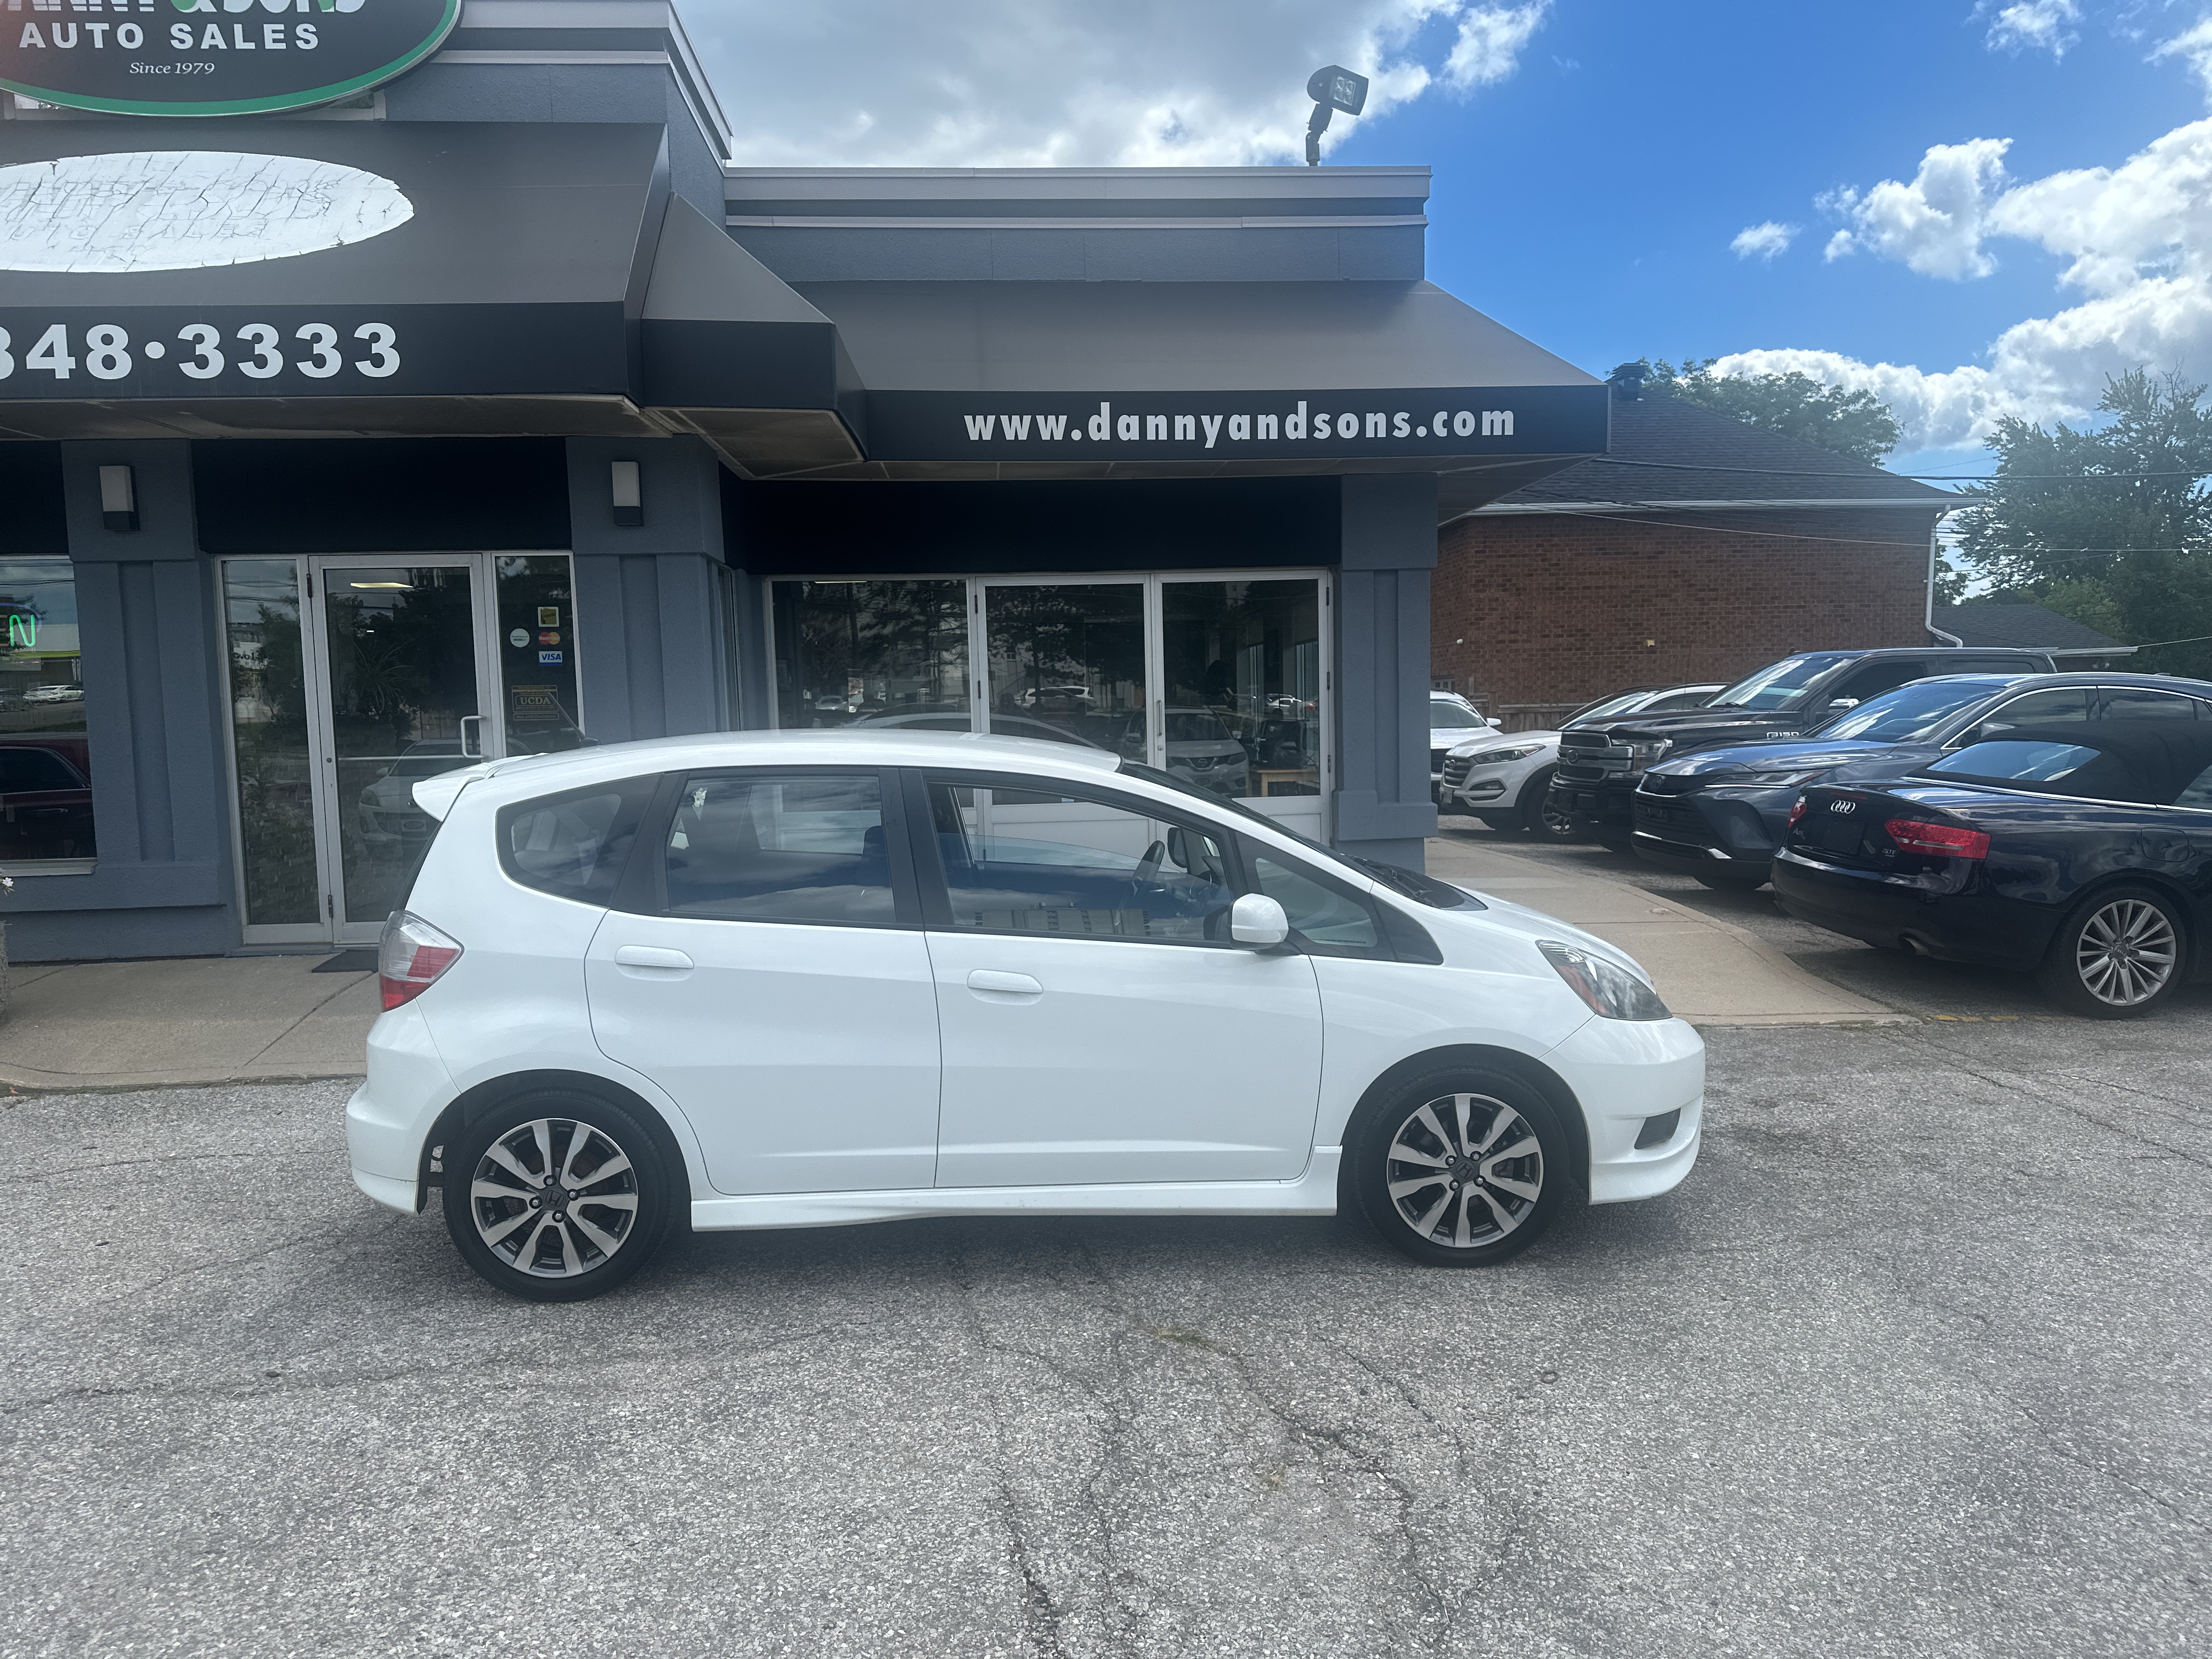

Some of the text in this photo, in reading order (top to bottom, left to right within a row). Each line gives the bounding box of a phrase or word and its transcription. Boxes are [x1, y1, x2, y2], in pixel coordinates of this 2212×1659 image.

[19, 22, 319, 50] AUTO SALES
[129, 61, 215, 75] Since 1979
[964, 401, 1515, 448] www.dannyandsons.com
[520, 697, 551, 705] UCDA
